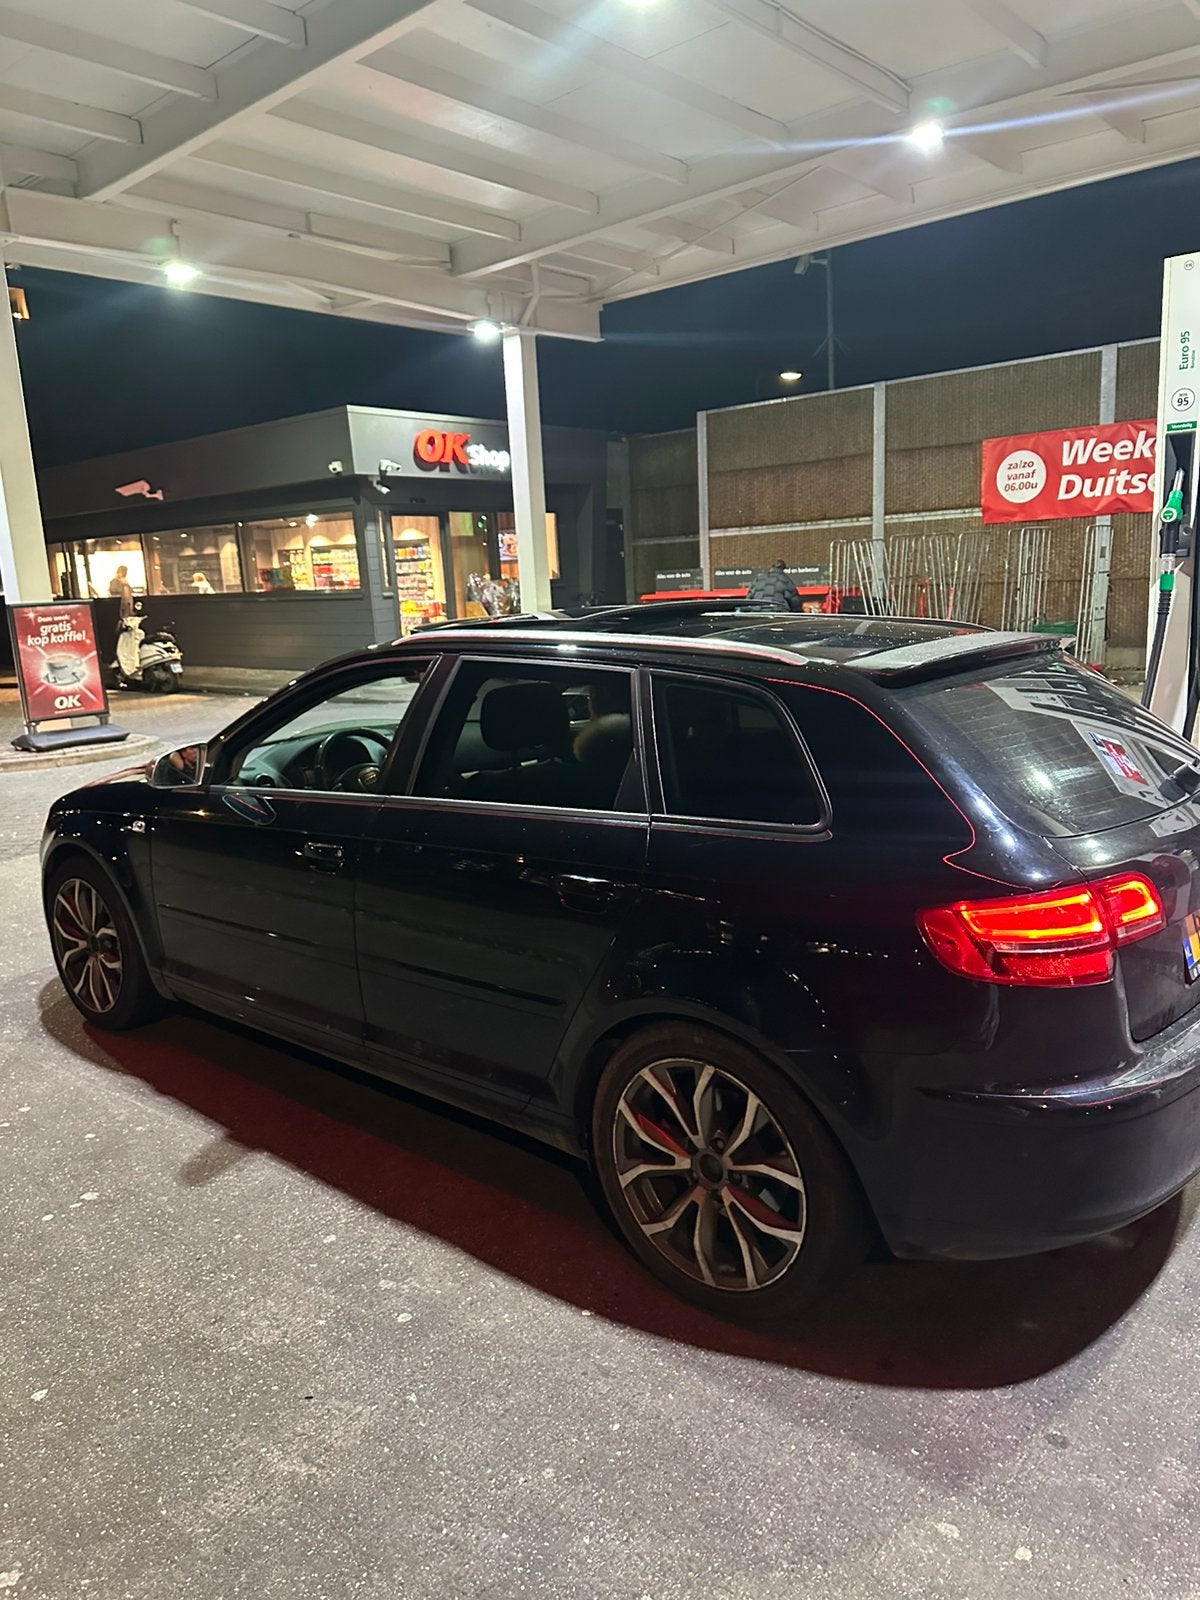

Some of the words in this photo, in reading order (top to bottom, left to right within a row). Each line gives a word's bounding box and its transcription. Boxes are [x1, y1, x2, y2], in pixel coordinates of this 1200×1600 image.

[1180, 330, 1190, 344] 95
[1179, 345, 1190, 370] Euro
[1177, 396, 1189, 407] 95
[413, 428, 471, 466] OK
[466, 443, 511, 473] Shop
[1061, 430, 1156, 467] Week
[1007, 459, 1035, 470] za/zo
[1007, 469, 1037, 481] vanaf
[1004, 481, 1038, 492] 06.00u
[40, 621, 72, 637] gratis
[27, 634, 50, 647] kop
[54, 694, 82, 710] OK
